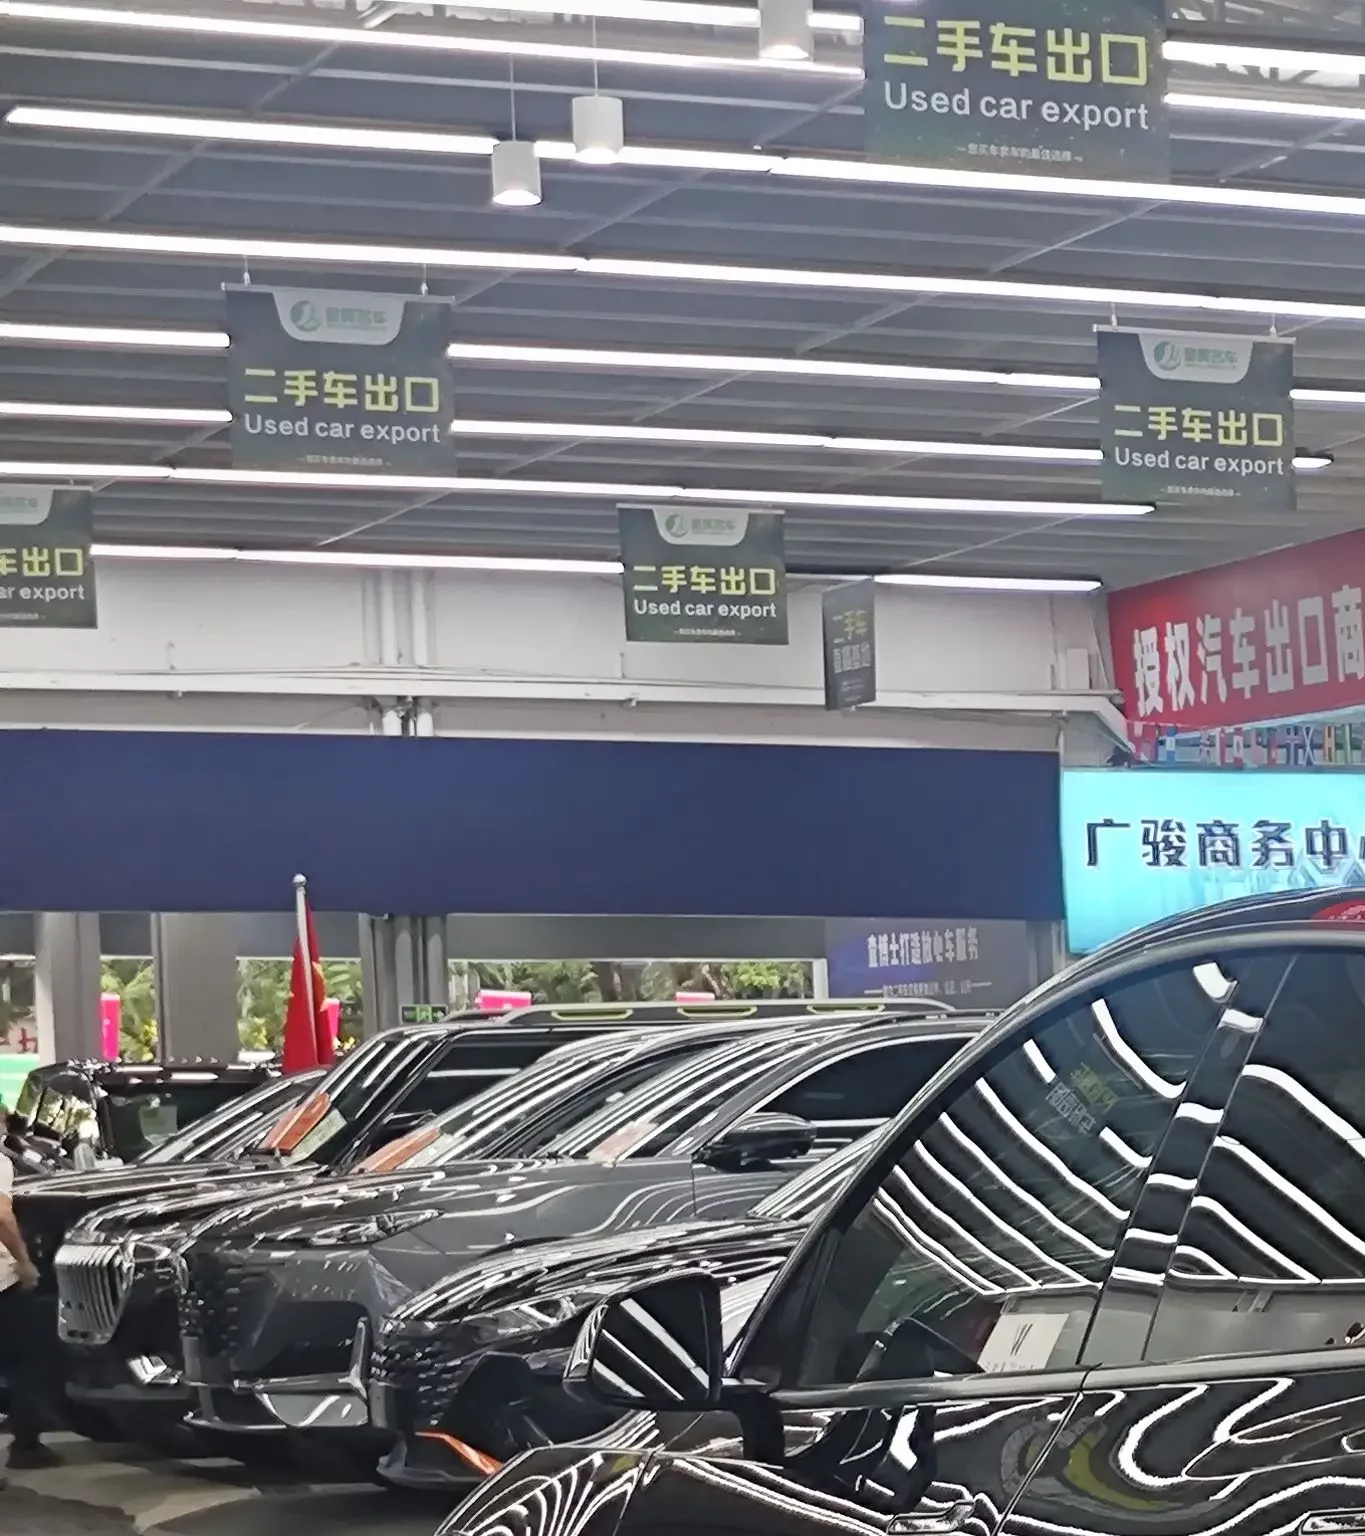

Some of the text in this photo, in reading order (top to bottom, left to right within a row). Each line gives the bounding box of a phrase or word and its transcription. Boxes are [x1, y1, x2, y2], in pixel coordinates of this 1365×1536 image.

[884, 15, 1147, 86] 二手车出口
[884, 81, 1149, 130] Used car export
[244, 368, 440, 412] 二手车出口
[244, 413, 441, 444] Used car export
[1114, 404, 1284, 447] 二手车出口
[1114, 446, 1284, 476] Used car export
[0, 585, 85, 602] ar export
[633, 565, 776, 596] 二手车出口
[634, 600, 777, 619] Used car export
[1133, 585, 1365, 719] 授权汽车出口商
